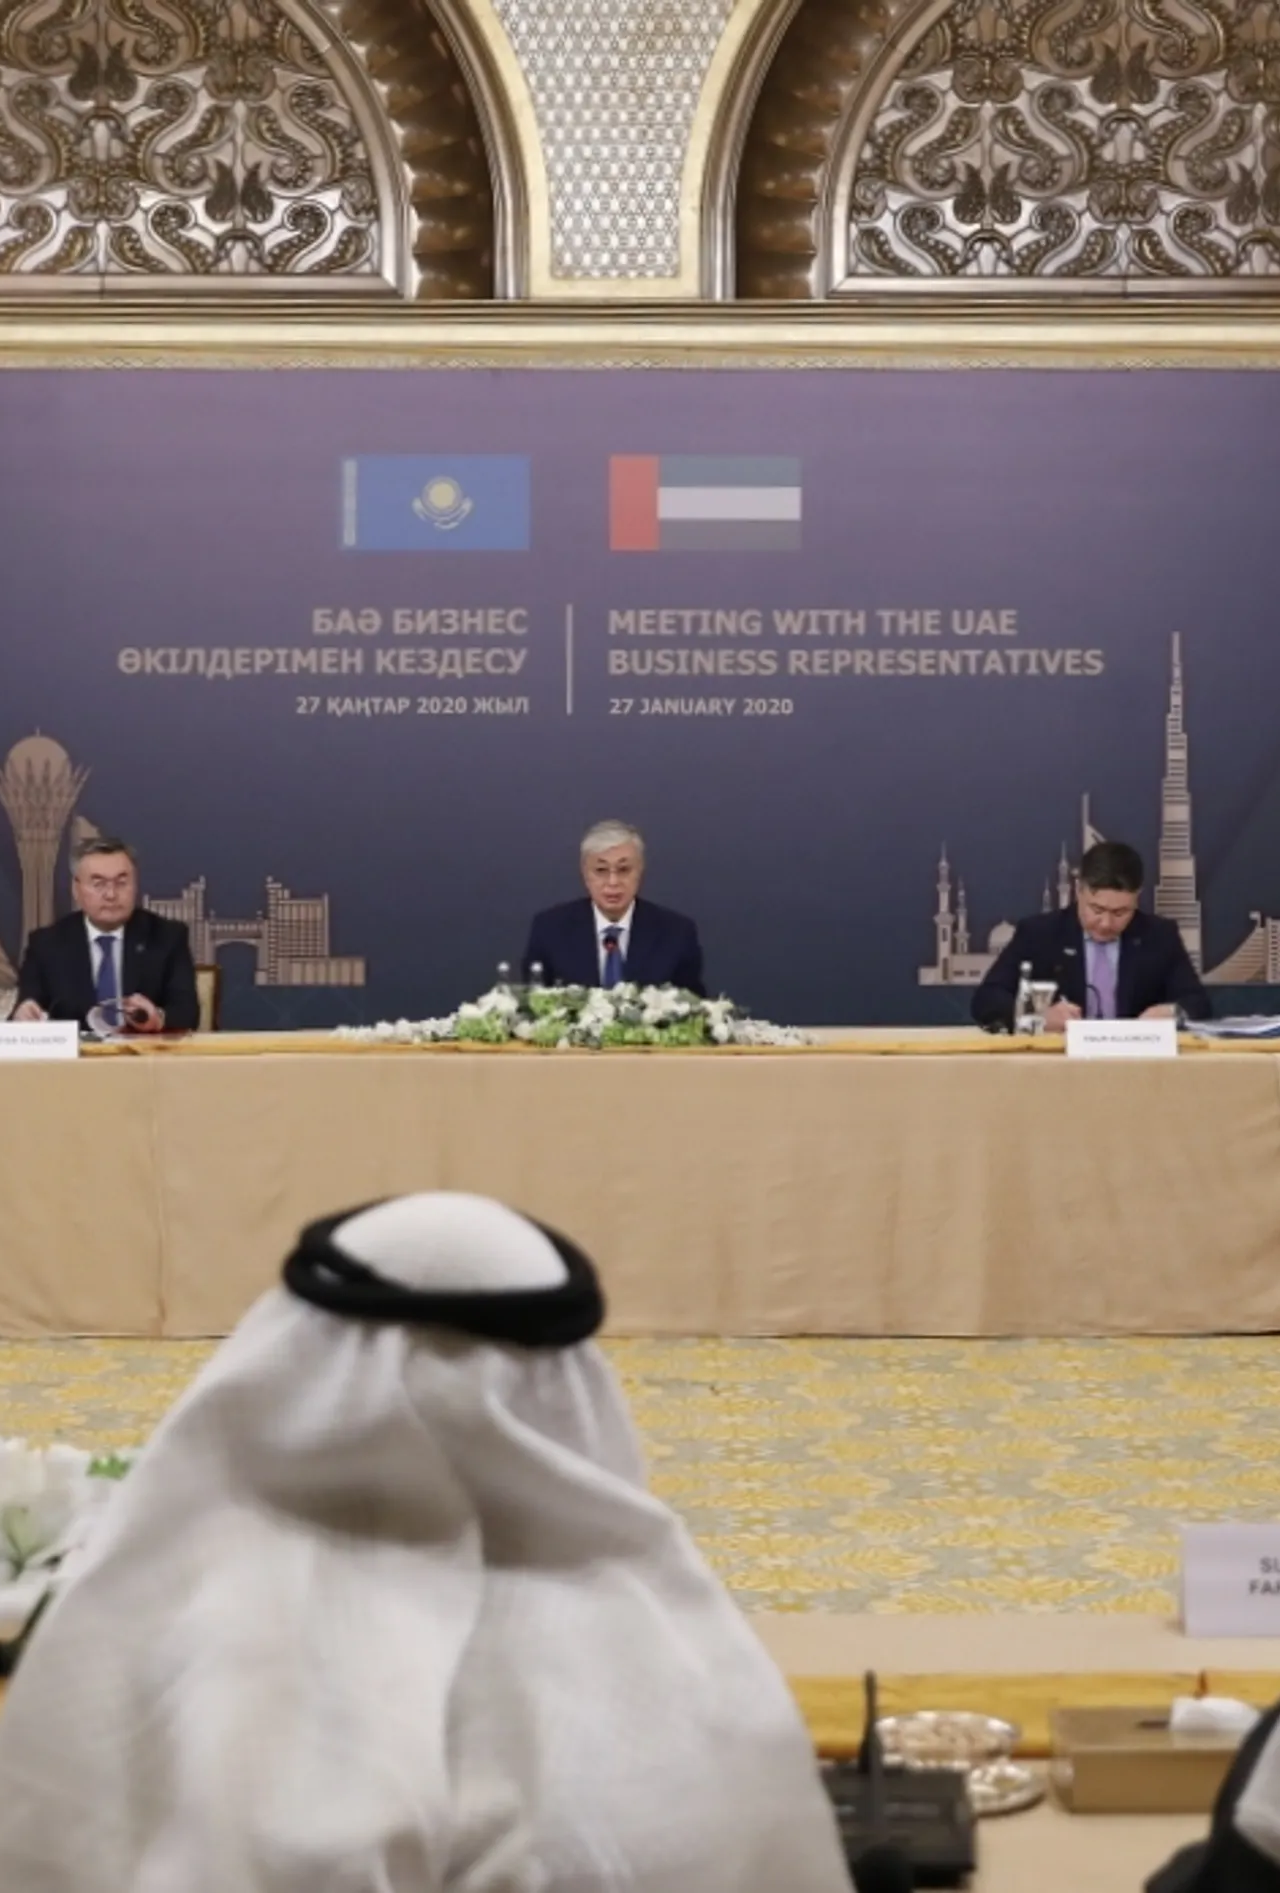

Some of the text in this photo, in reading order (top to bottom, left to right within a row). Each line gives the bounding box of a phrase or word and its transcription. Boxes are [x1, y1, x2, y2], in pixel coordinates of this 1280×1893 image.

[312, 608, 529, 635] БАӘ БИЗНЕС
[607, 609, 1018, 635] MEETING WITH THE UAE
[117, 647, 528, 679] ӨКІЛДЕРІМЕН КЕЗДЕСУ
[608, 649, 1106, 676] BUSINESS REPRESENTATIVES
[296, 697, 530, 718] 27 ҚАҢТАР 2020 ЖЫЛ
[609, 698, 794, 715] 27 JANUARY 2020
